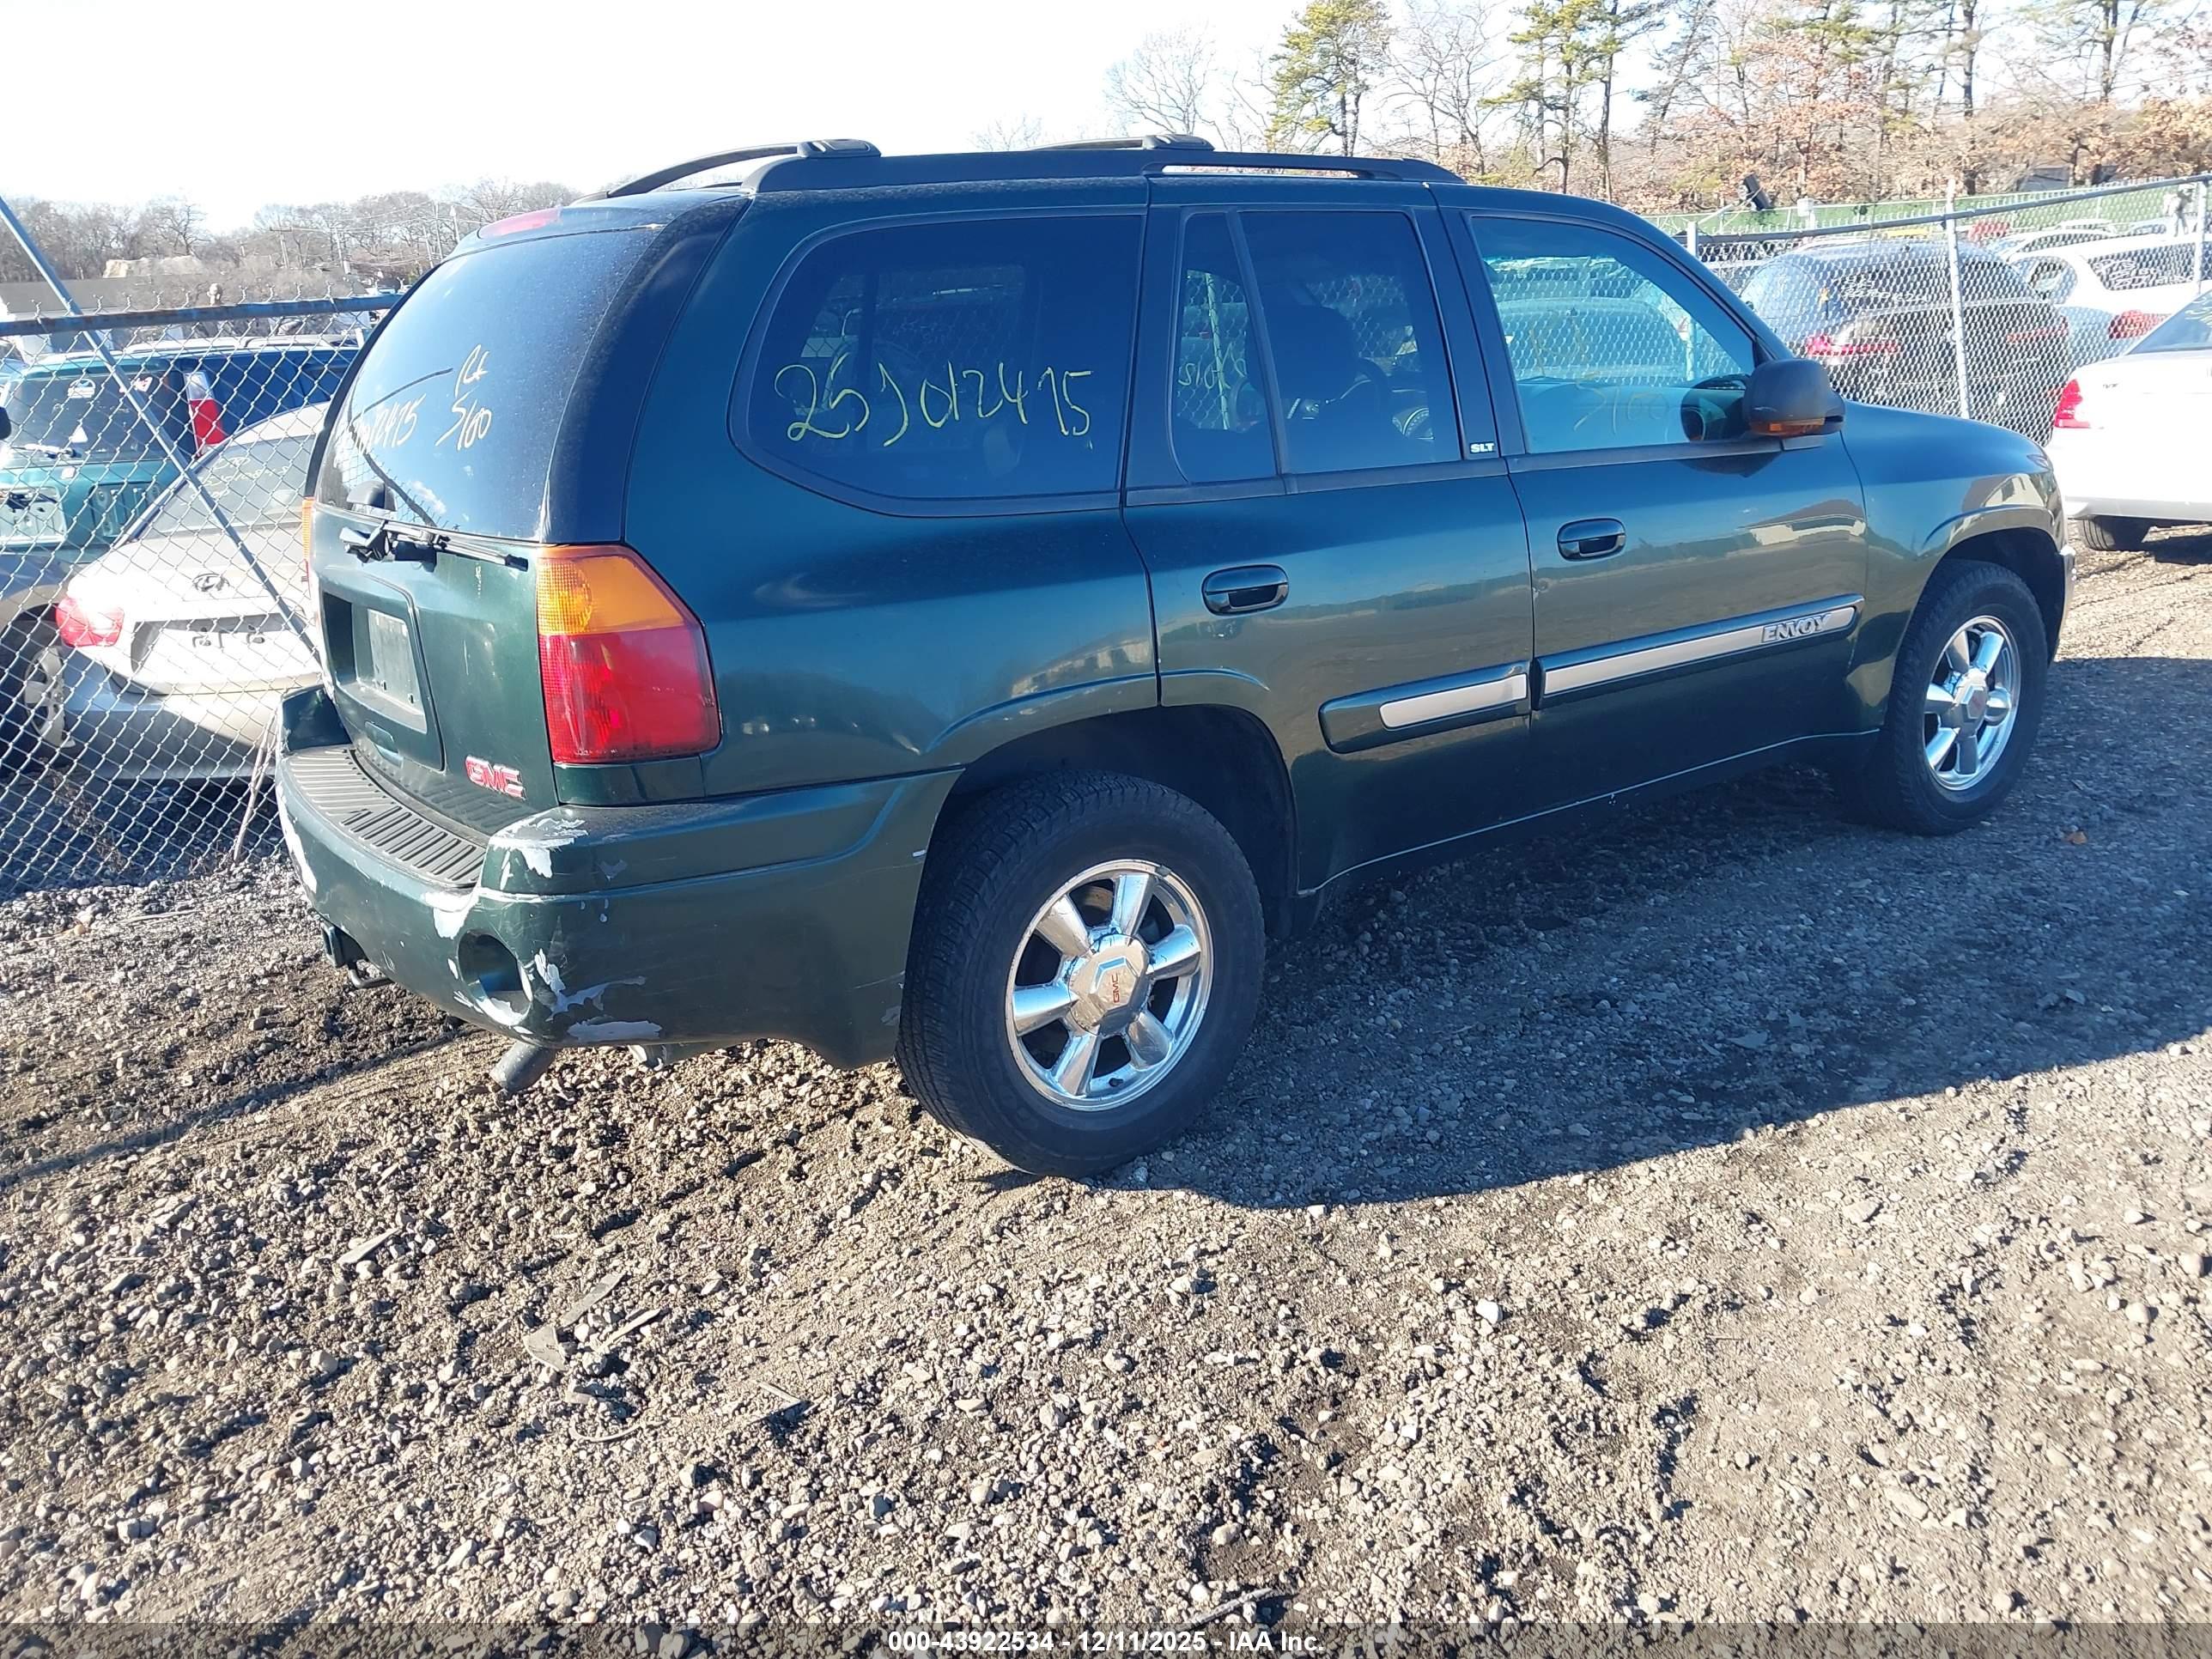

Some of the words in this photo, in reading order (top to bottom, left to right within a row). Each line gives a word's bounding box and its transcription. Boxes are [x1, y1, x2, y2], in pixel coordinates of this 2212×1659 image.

[1470, 442, 1495, 453] SLT
[1761, 612, 1832, 643] ENVOY
[465, 755, 527, 800] GMC
[1111, 972, 1121, 1003] GMC
